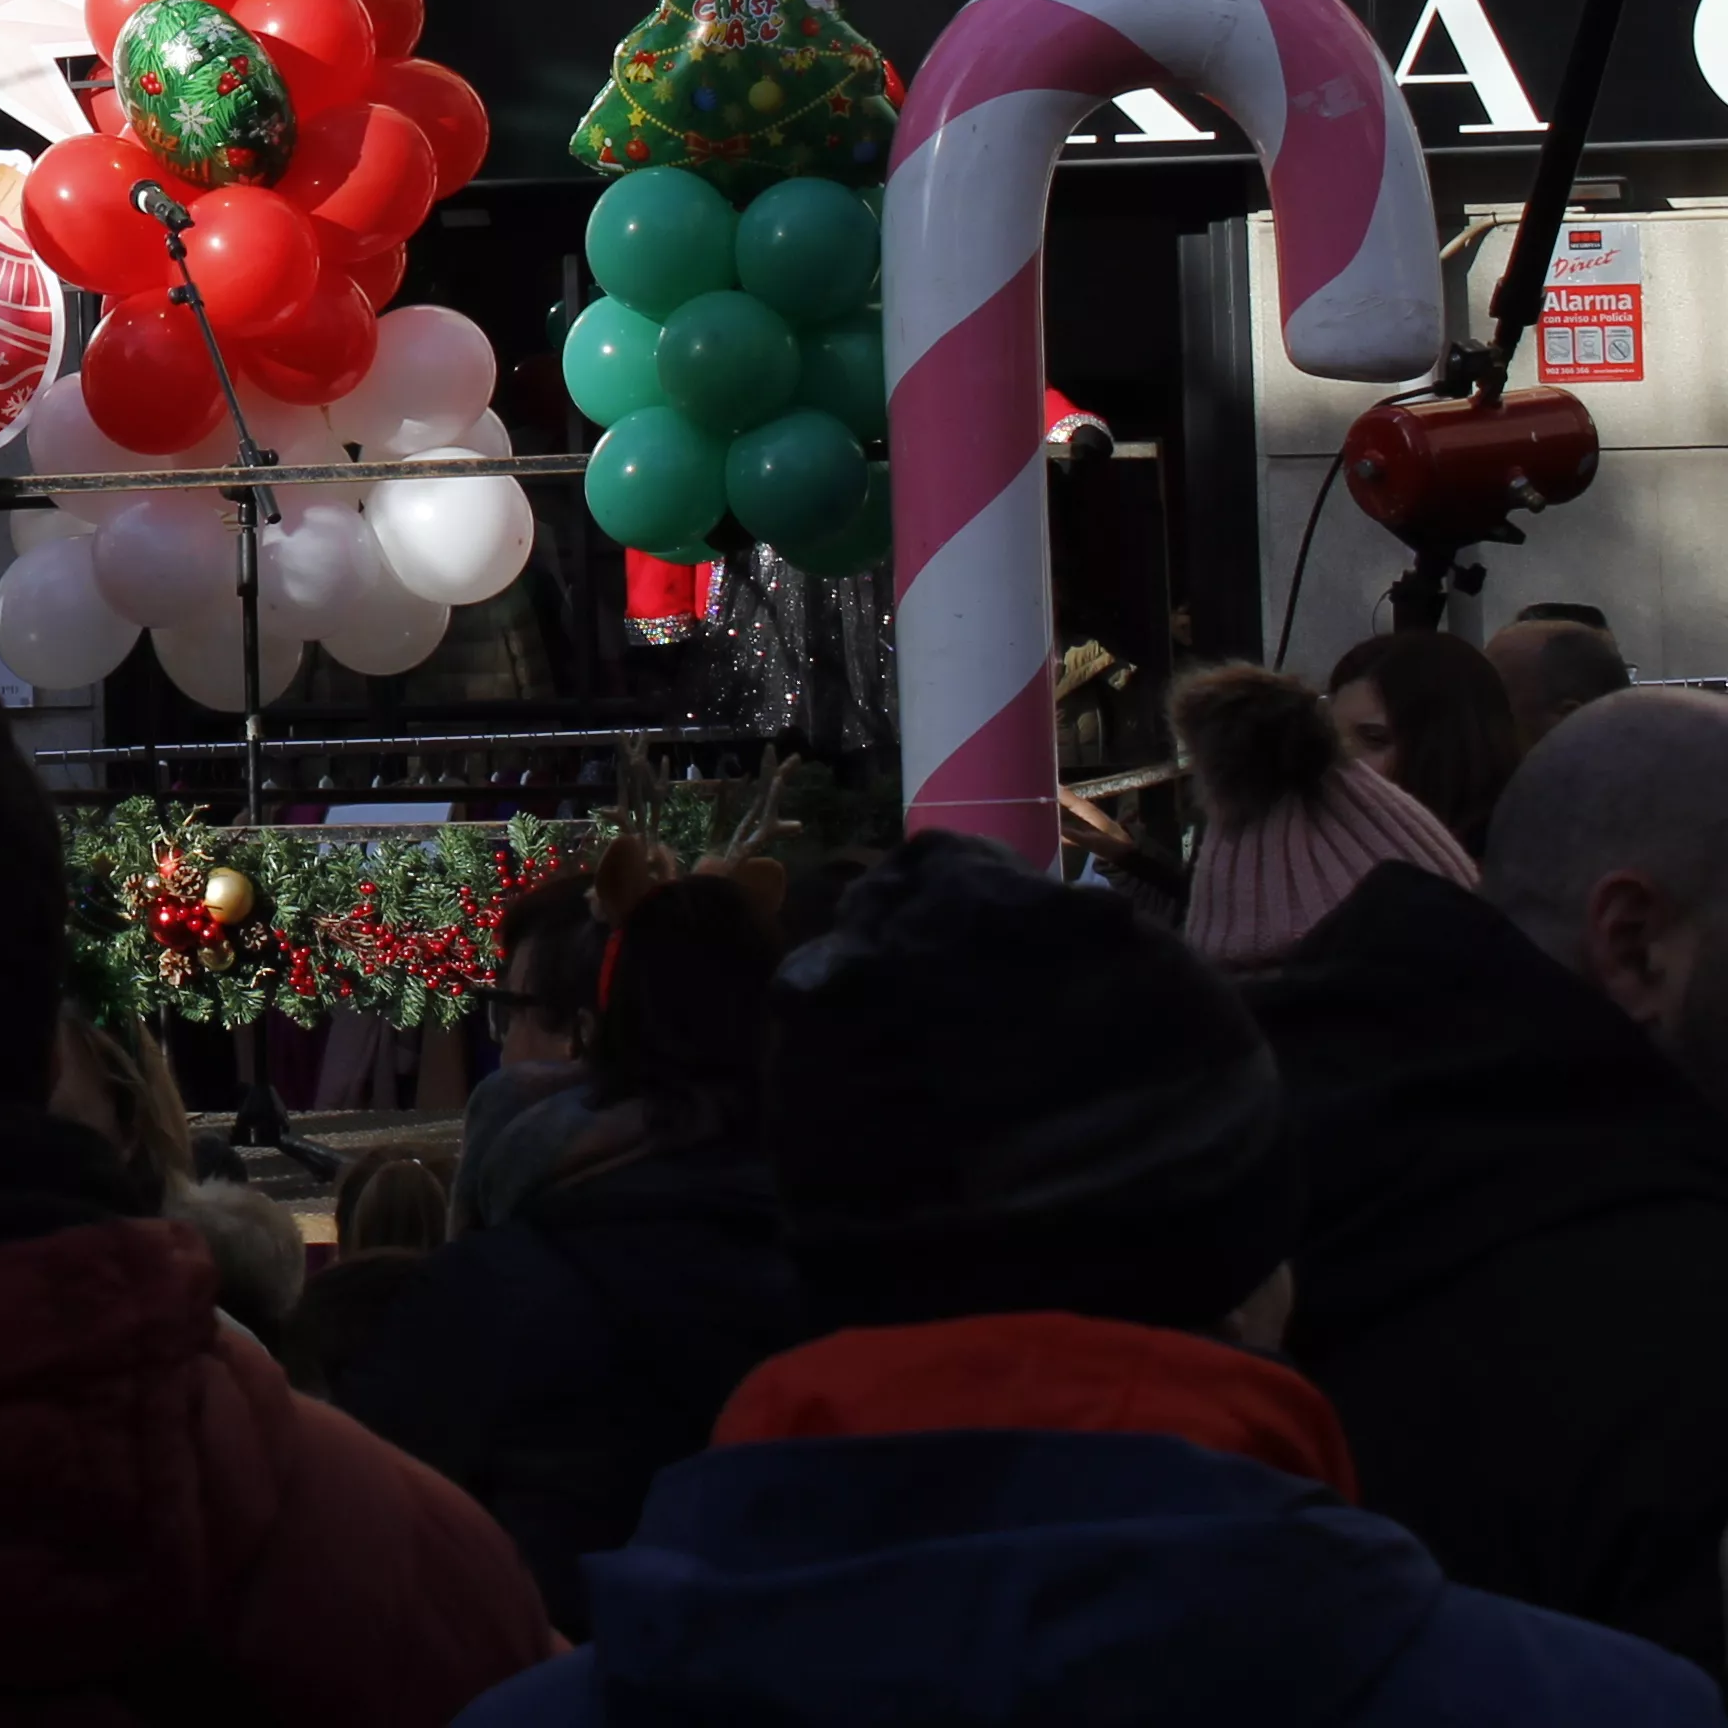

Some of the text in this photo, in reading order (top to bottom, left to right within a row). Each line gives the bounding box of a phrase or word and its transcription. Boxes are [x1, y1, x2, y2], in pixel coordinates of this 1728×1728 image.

[1552, 249, 1621, 278] Direct
[1543, 290, 1633, 312] Alarma
[1544, 316, 1561, 324] con
[1563, 313, 1589, 323] aviso
[1591, 315, 1598, 323] a
